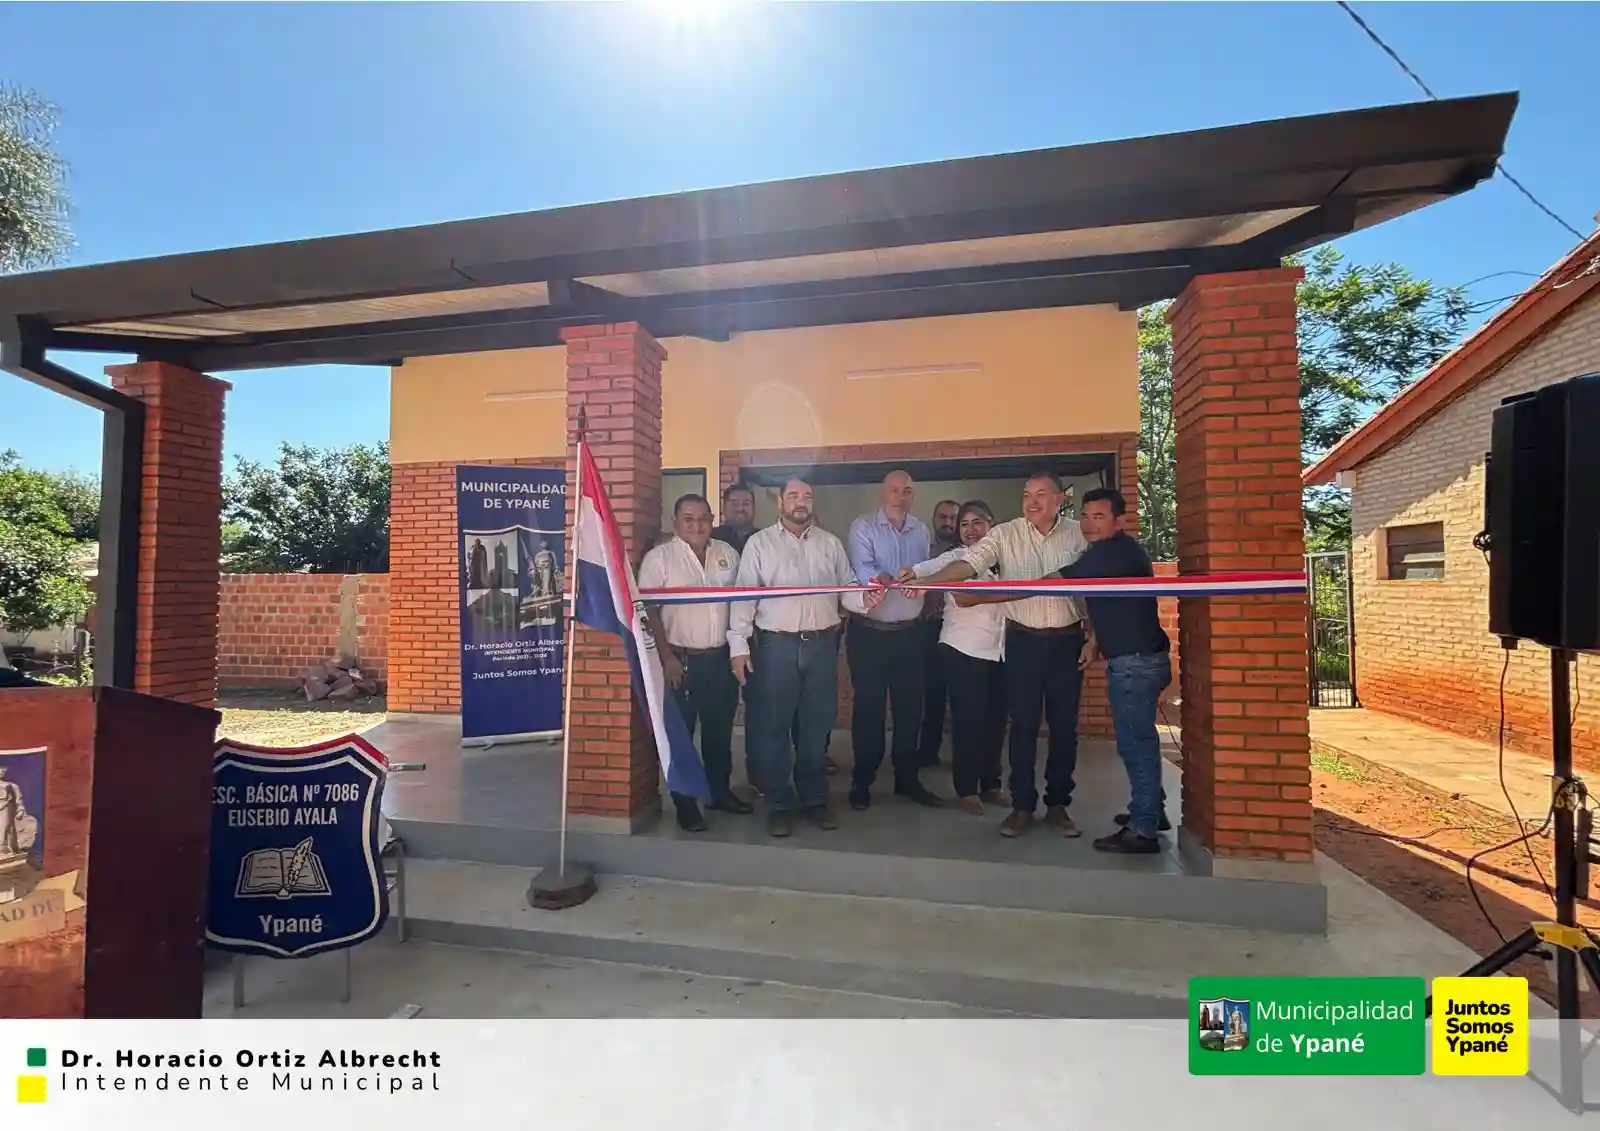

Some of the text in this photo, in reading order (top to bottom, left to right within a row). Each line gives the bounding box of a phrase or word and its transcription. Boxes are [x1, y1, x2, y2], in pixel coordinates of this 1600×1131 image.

[484, 496, 550, 509] DE YPANÉ
[480, 641, 513, 650] Horacio
[515, 640, 536, 648] Ortiz
[472, 671, 505, 680] Juntos
[507, 668, 537, 677] Somos
[246, 782, 298, 803] BÁSICA
[324, 783, 359, 802] 7086
[228, 807, 338, 827] EUSEBIO AYALA
[259, 914, 323, 937] Ypané
